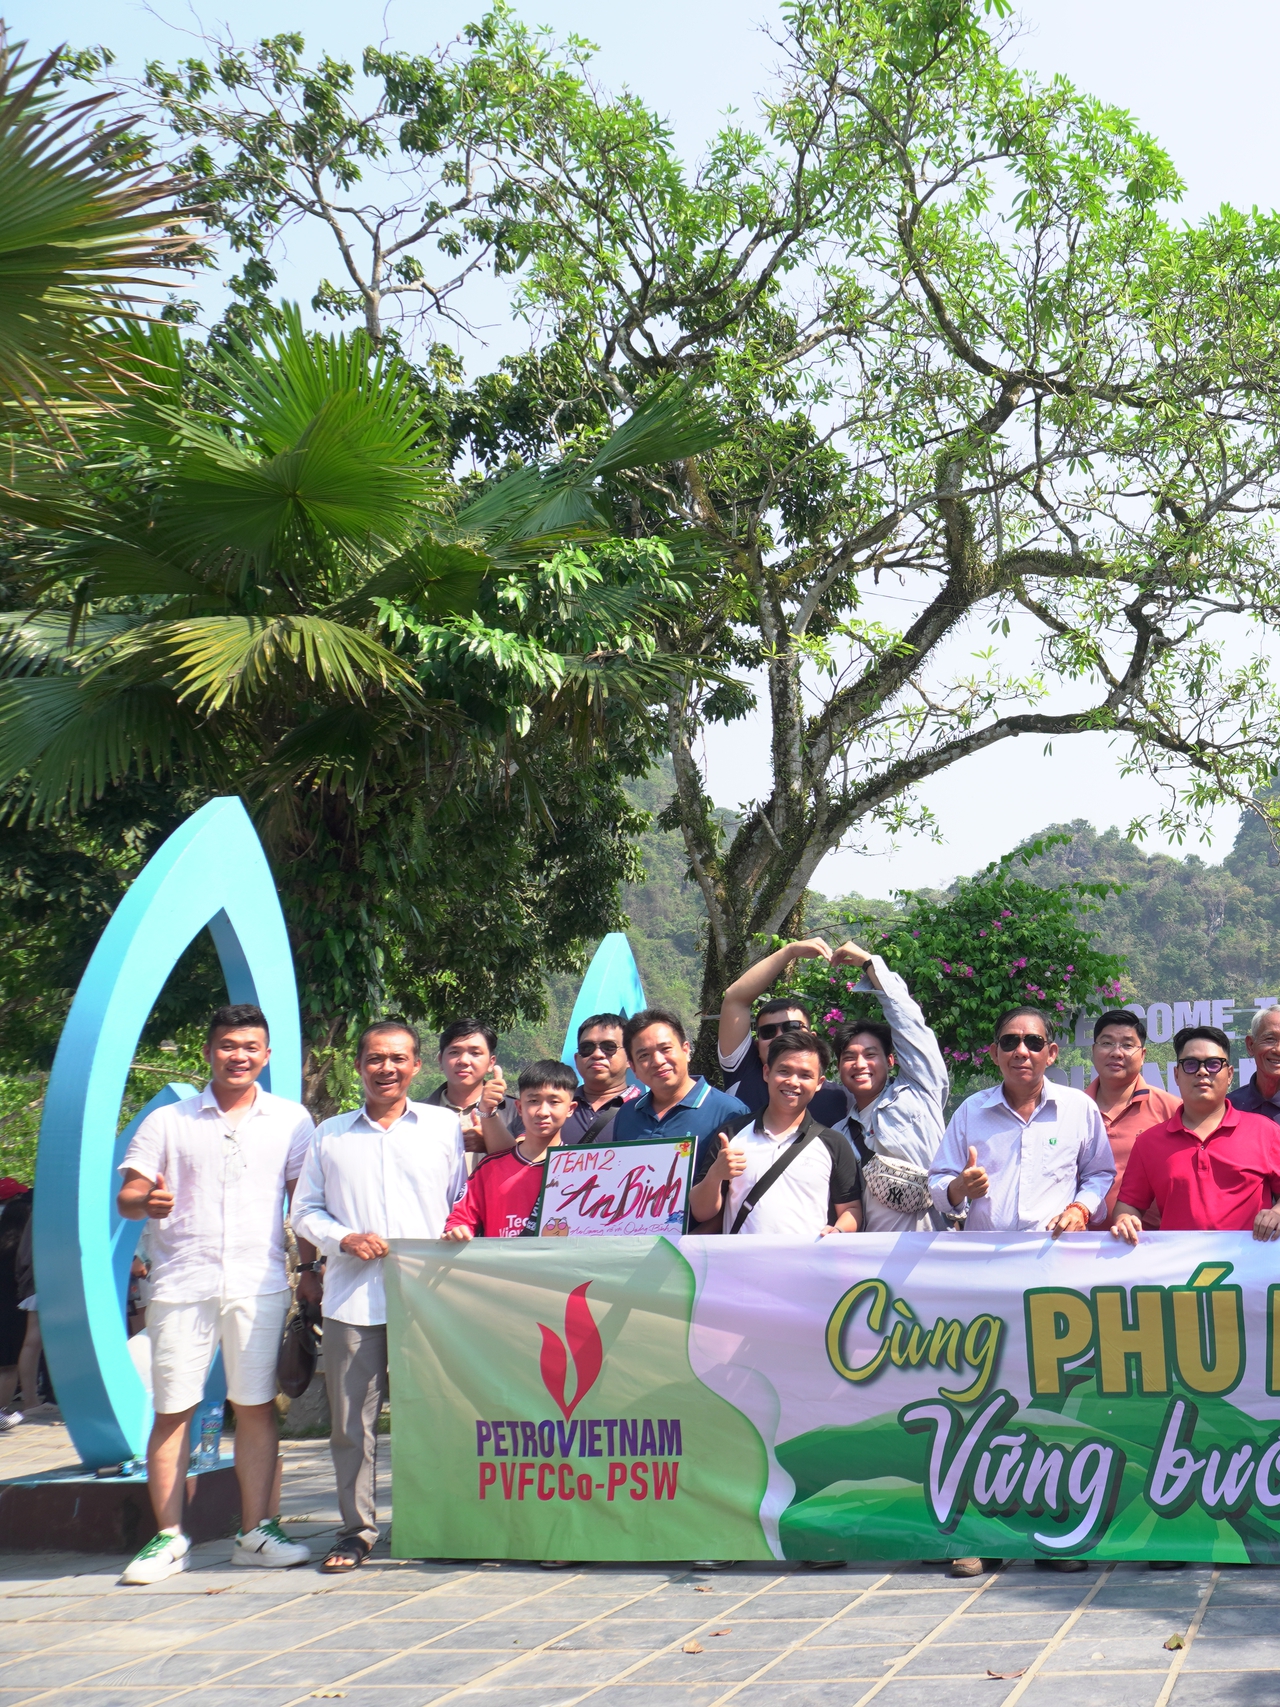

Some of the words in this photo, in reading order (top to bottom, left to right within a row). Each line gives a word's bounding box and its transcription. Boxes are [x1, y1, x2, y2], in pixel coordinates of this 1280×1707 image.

[550, 1151, 599, 1173] TEAM
[556, 1174, 615, 1219] An
[605, 1151, 682, 1226] Bình
[825, 1279, 1003, 1403] Cùng
[1025, 1262, 1245, 1397] PHÚ
[476, 1419, 682, 1458] PETROVIETNAM
[479, 1462, 679, 1501] PVFCCo-PSW
[900, 1392, 1118, 1551] Vững
